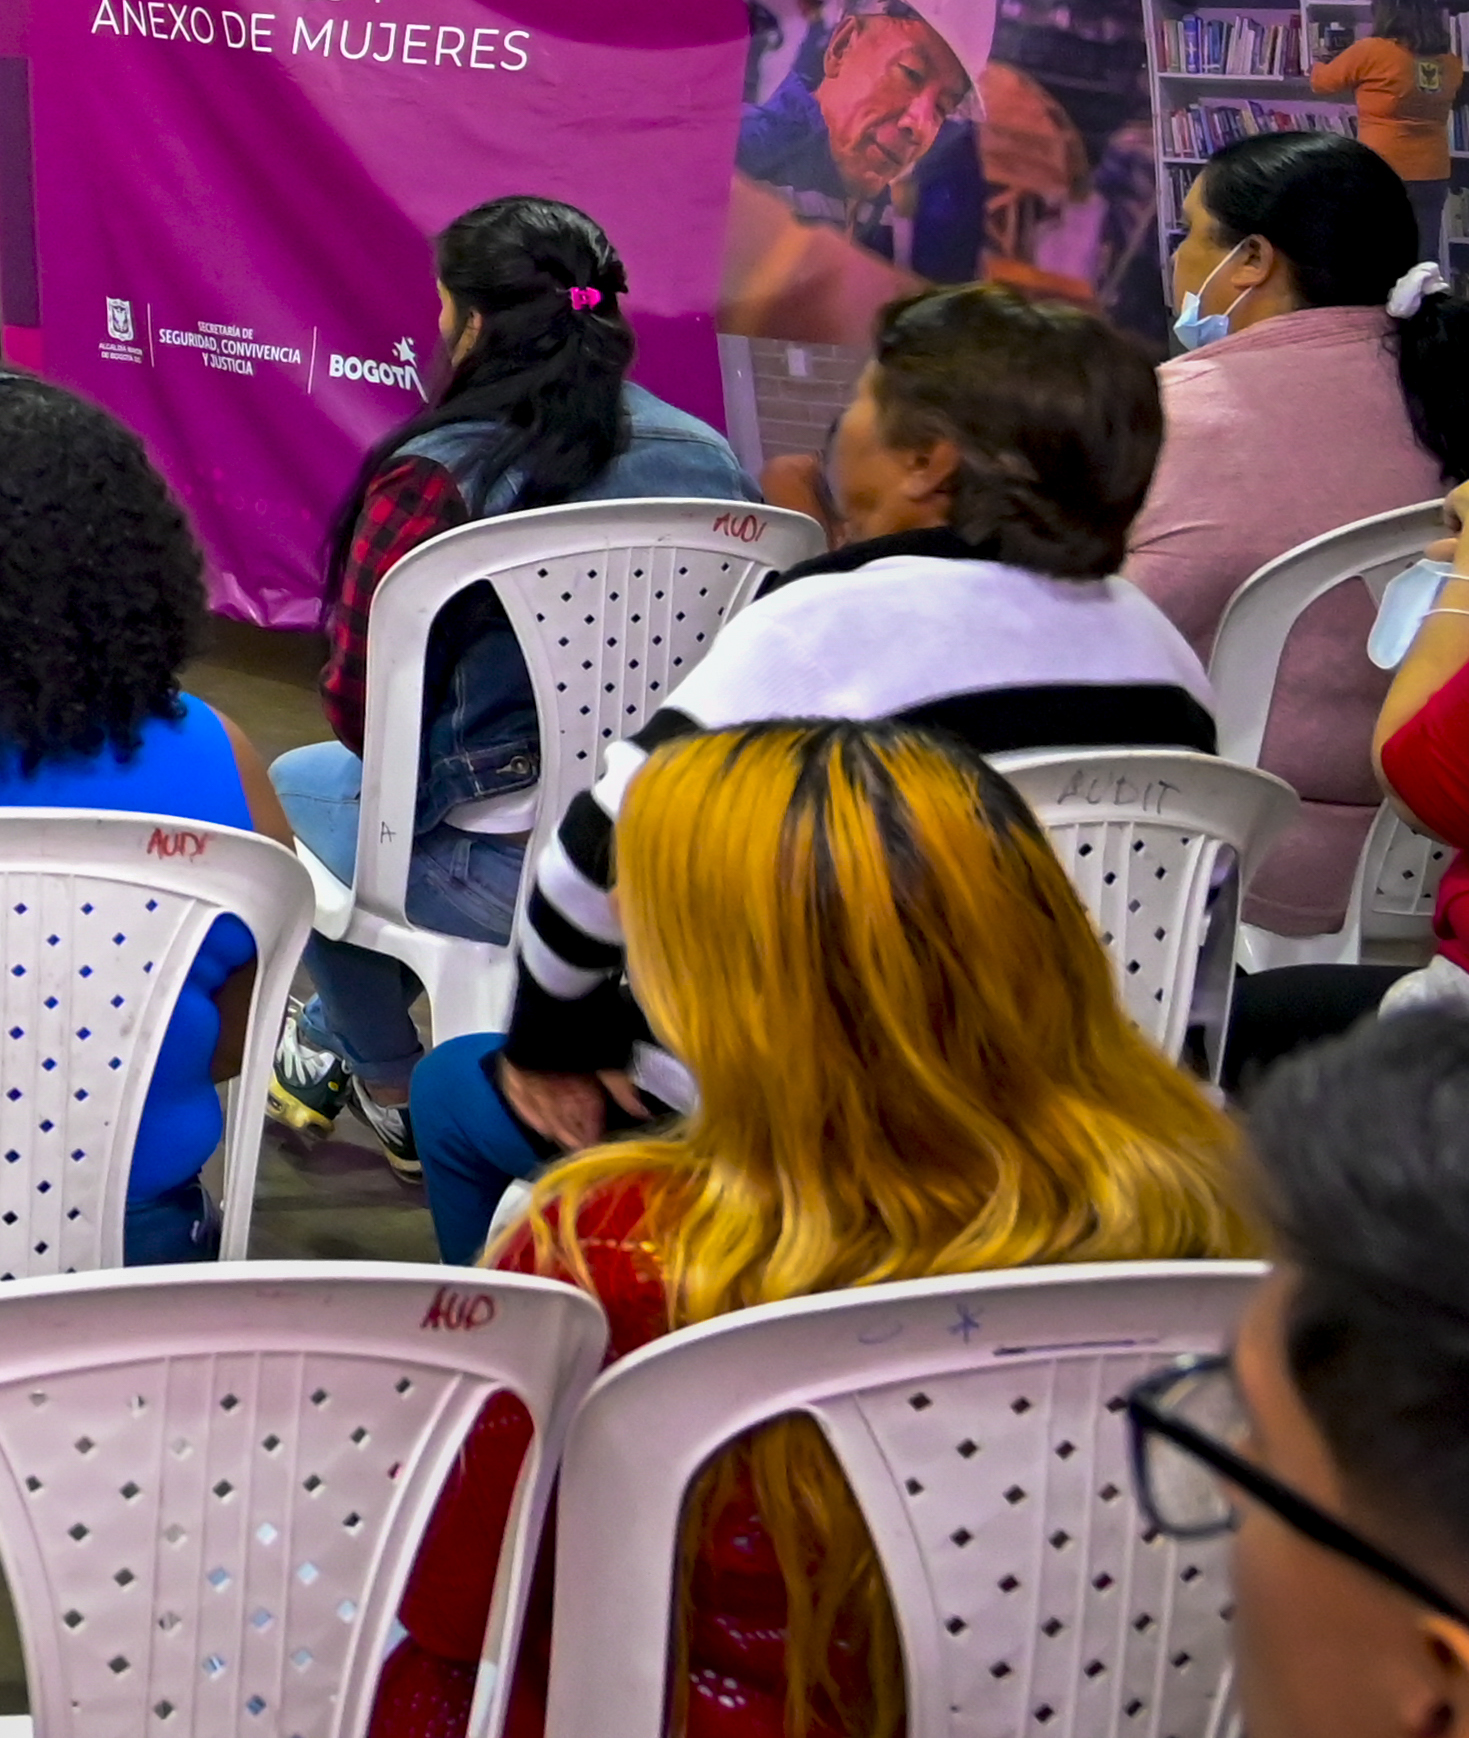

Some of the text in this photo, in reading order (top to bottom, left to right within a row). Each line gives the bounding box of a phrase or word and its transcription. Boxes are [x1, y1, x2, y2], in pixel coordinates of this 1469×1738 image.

[220, 9, 277, 53] DE
[291, 16, 531, 72] MUJERES
[158, 328, 302, 364] SEGURIDAD, CONVIVENCIA
[242, 327, 254, 340] DE
[202, 352, 255, 376] Y JUSTICIA
